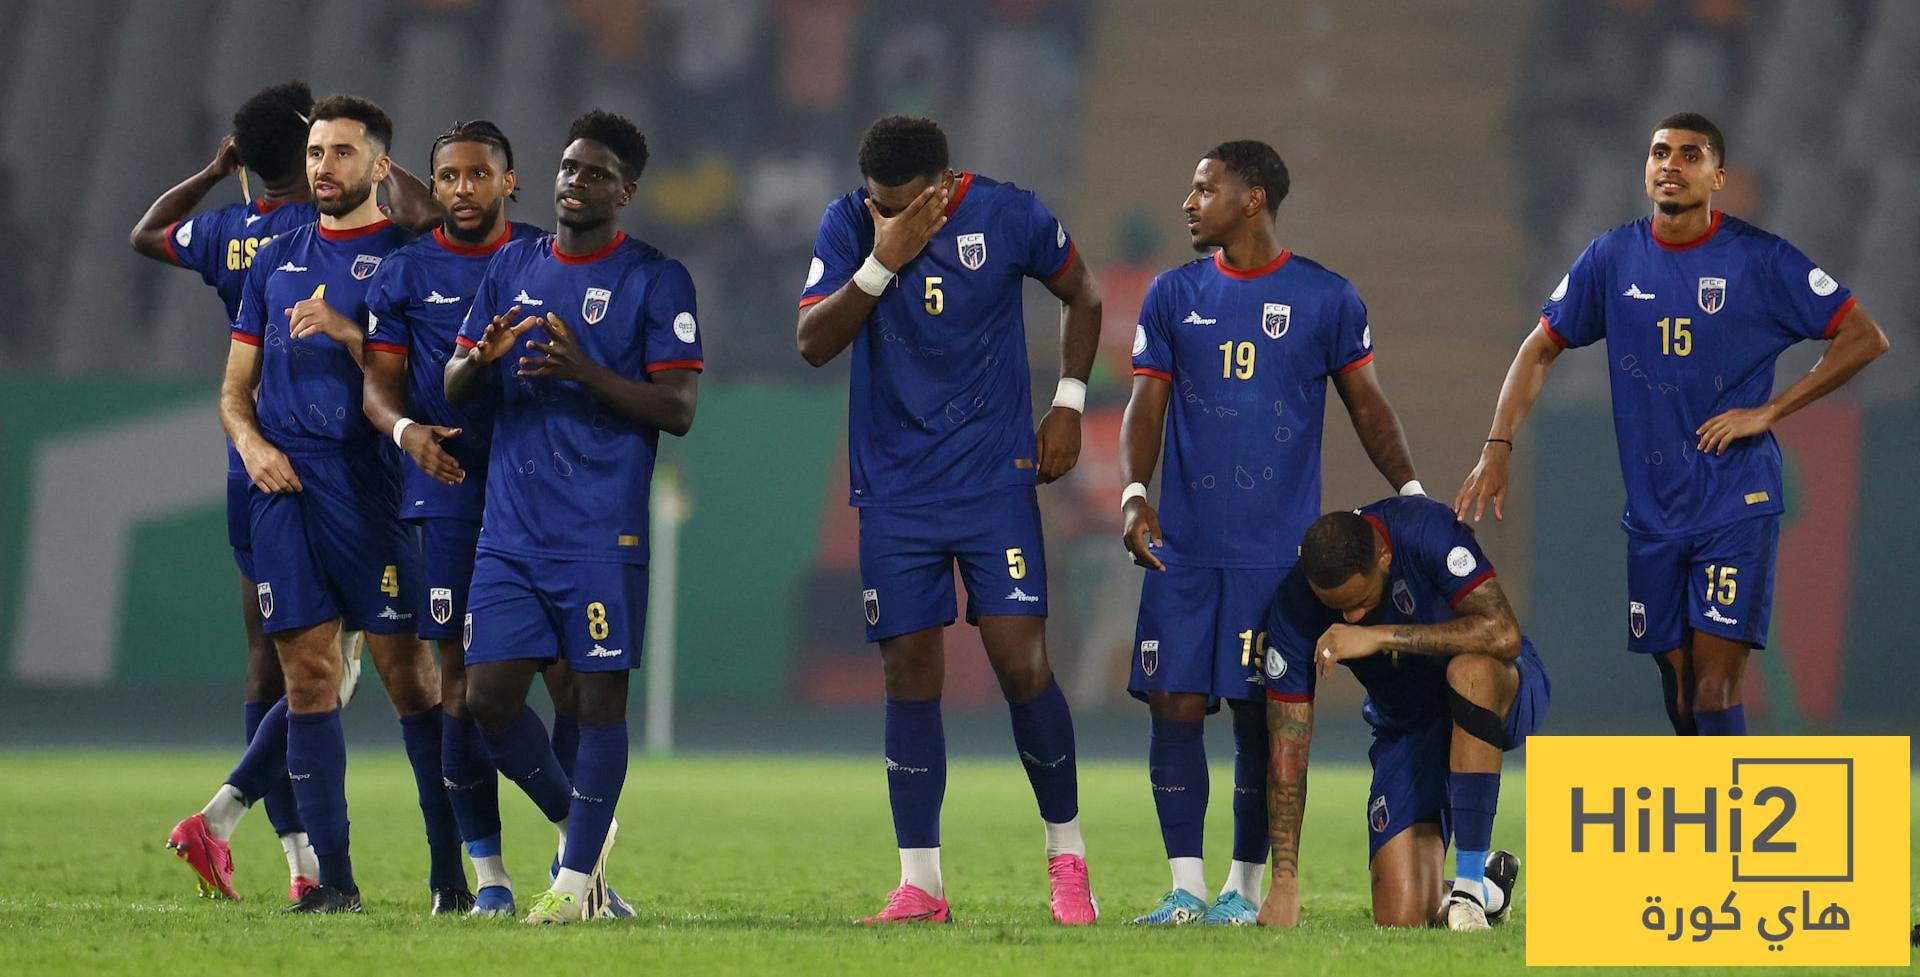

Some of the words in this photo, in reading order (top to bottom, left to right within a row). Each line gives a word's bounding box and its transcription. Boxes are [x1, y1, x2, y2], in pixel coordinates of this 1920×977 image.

[924, 276, 944, 316] 5
[1656, 316, 1693, 357] 15
[1219, 340, 1256, 381] 19
[380, 564, 399, 598] 4
[1005, 547, 1027, 580] 5
[1704, 564, 1738, 606] 15
[586, 601, 610, 641] 8
